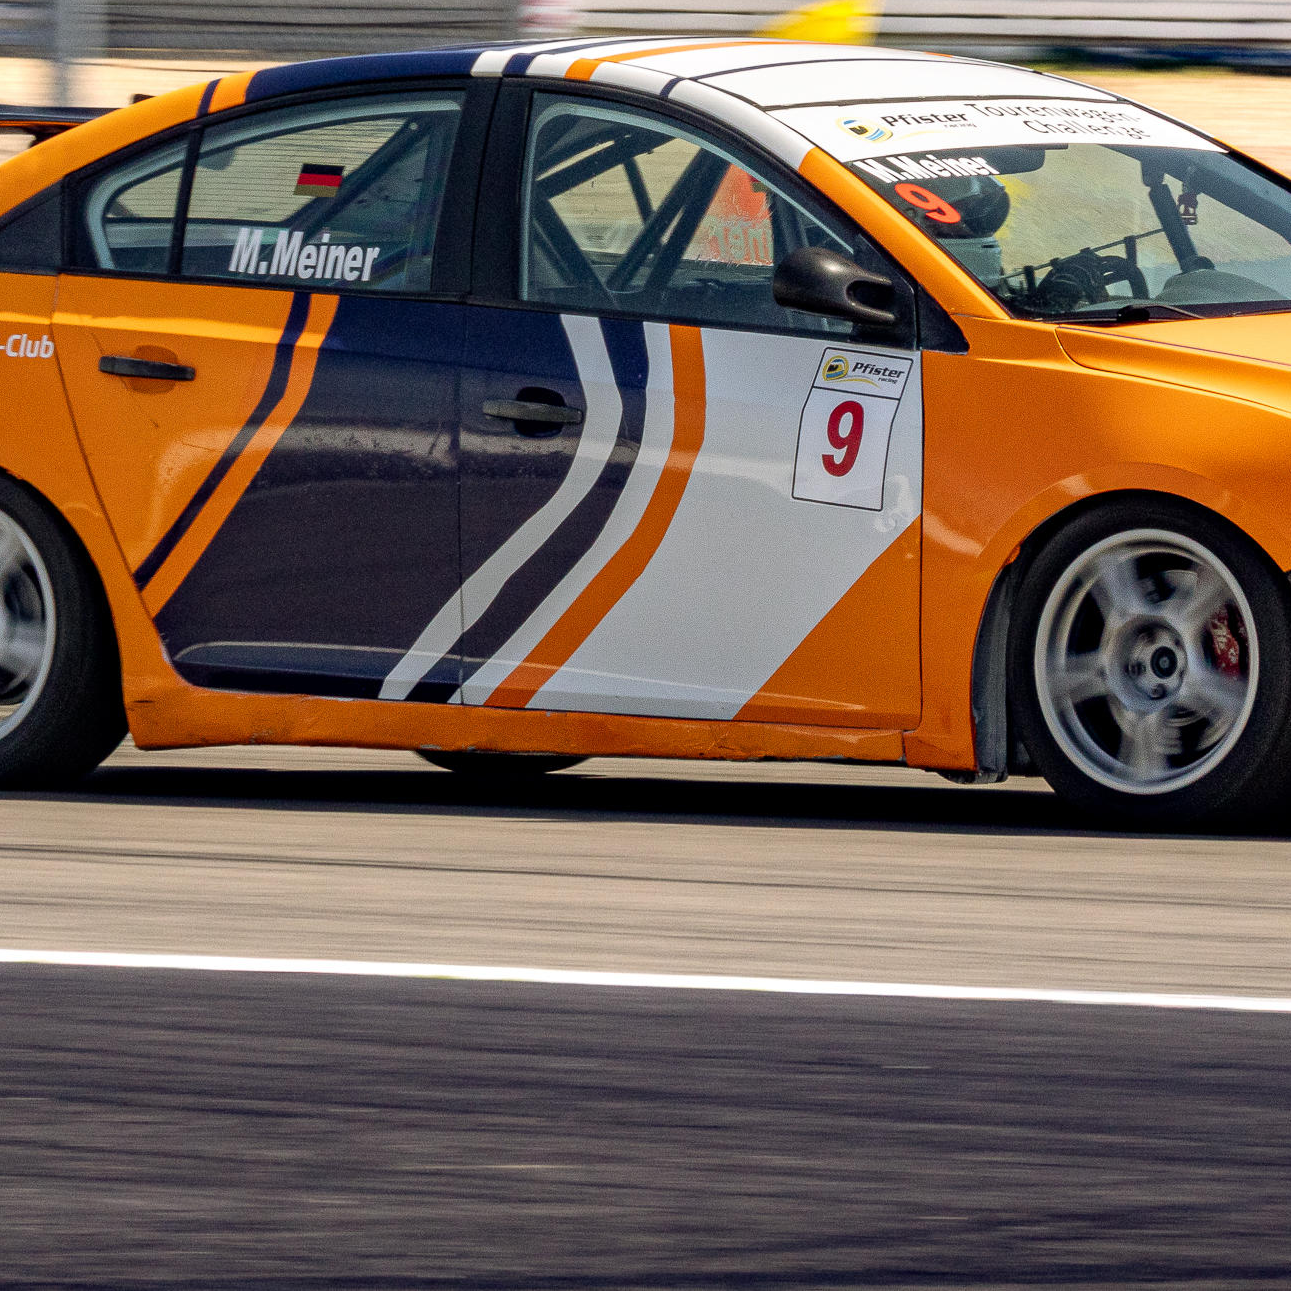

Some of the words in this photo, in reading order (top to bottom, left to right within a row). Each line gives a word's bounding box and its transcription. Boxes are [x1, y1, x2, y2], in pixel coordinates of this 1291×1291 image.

[881, 112, 968, 127] Pfister
[853, 155, 1000, 183] M.Meiner
[895, 183, 961, 223] 9
[228, 227, 380, 281] M.Meiner
[852, 362, 905, 379] Pfister
[822, 400, 864, 477] 9
